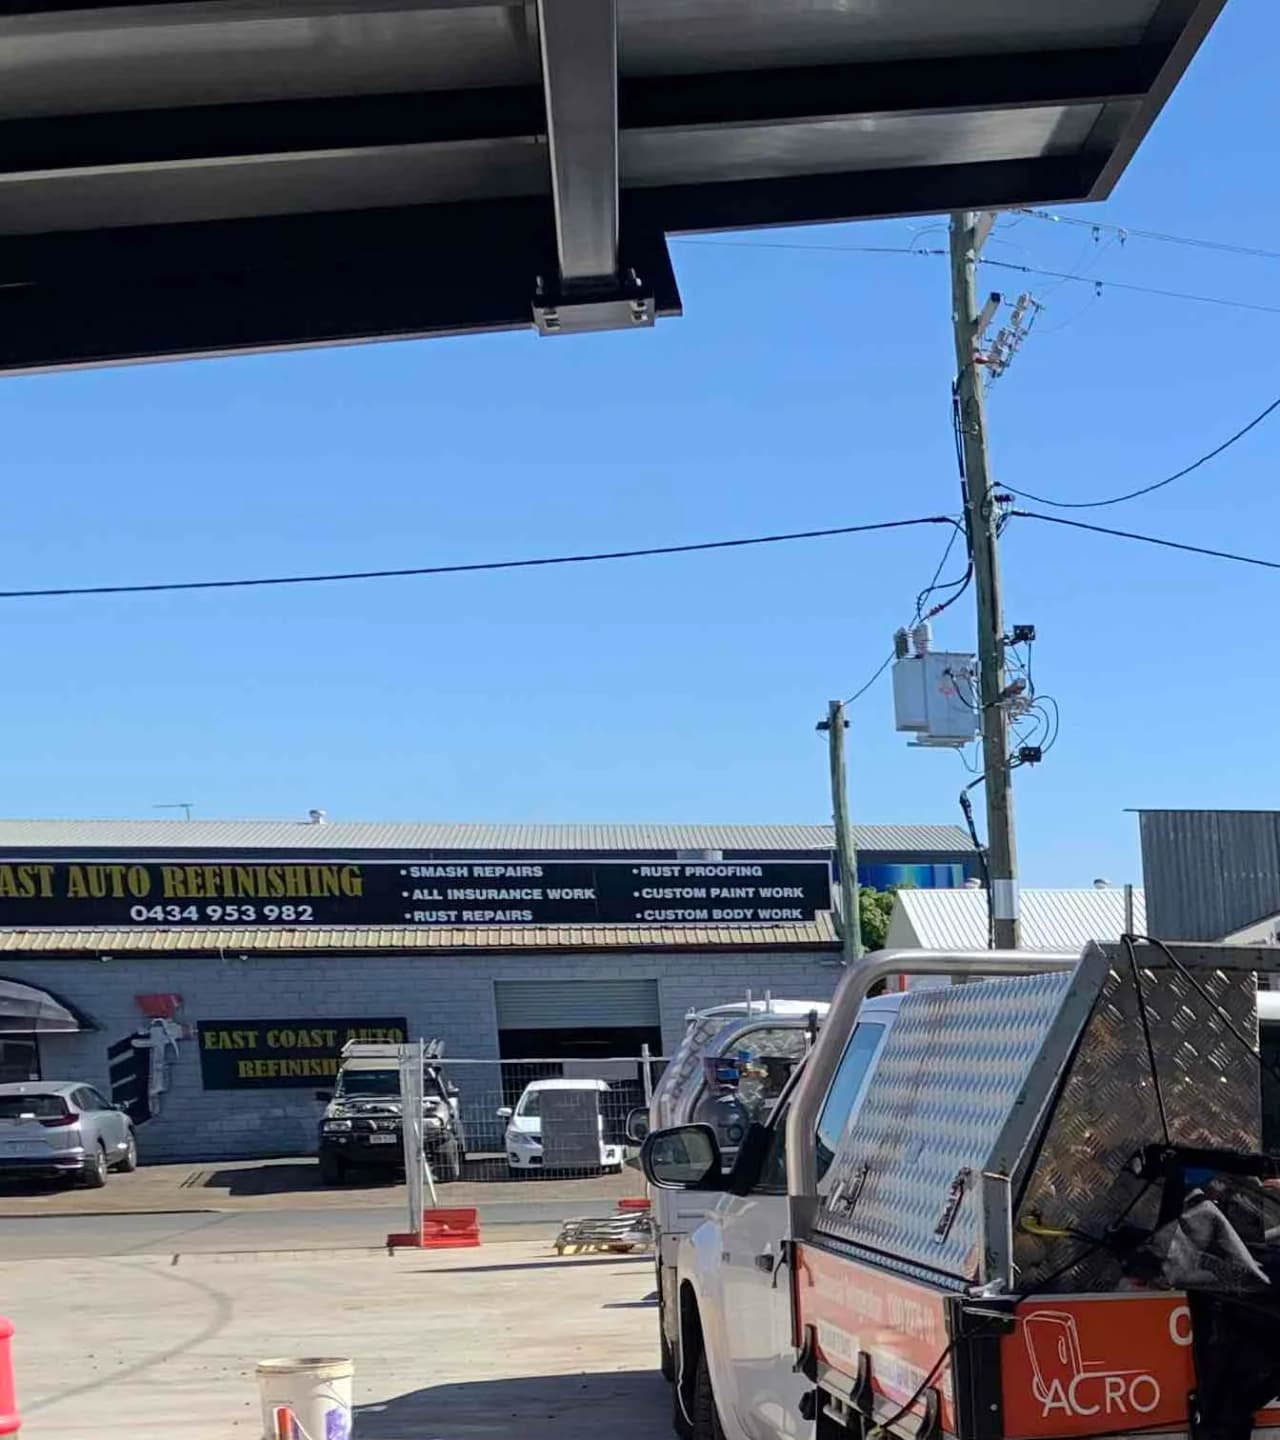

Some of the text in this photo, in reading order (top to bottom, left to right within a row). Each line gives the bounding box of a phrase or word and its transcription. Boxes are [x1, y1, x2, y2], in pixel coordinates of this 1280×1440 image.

[410, 866, 544, 878] SMASH REPAIRS
[640, 866, 763, 877] RUST PROOFING
[67, 865, 151, 898] AUTO
[161, 865, 363, 898] REFINISHING
[412, 888, 596, 900] ALL INSURANCE WORK
[642, 887, 805, 899] CUSTOM PAINT WORK
[130, 905, 314, 922] 0434 953 982
[413, 910, 533, 922] RUST REPAIRS
[644, 908, 803, 921] CUSTOM BODY WORK
[203, 1030, 259, 1049] EAST
[266, 1029, 337, 1048] COAST
[1040, 1374, 1160, 1418] ACRO
